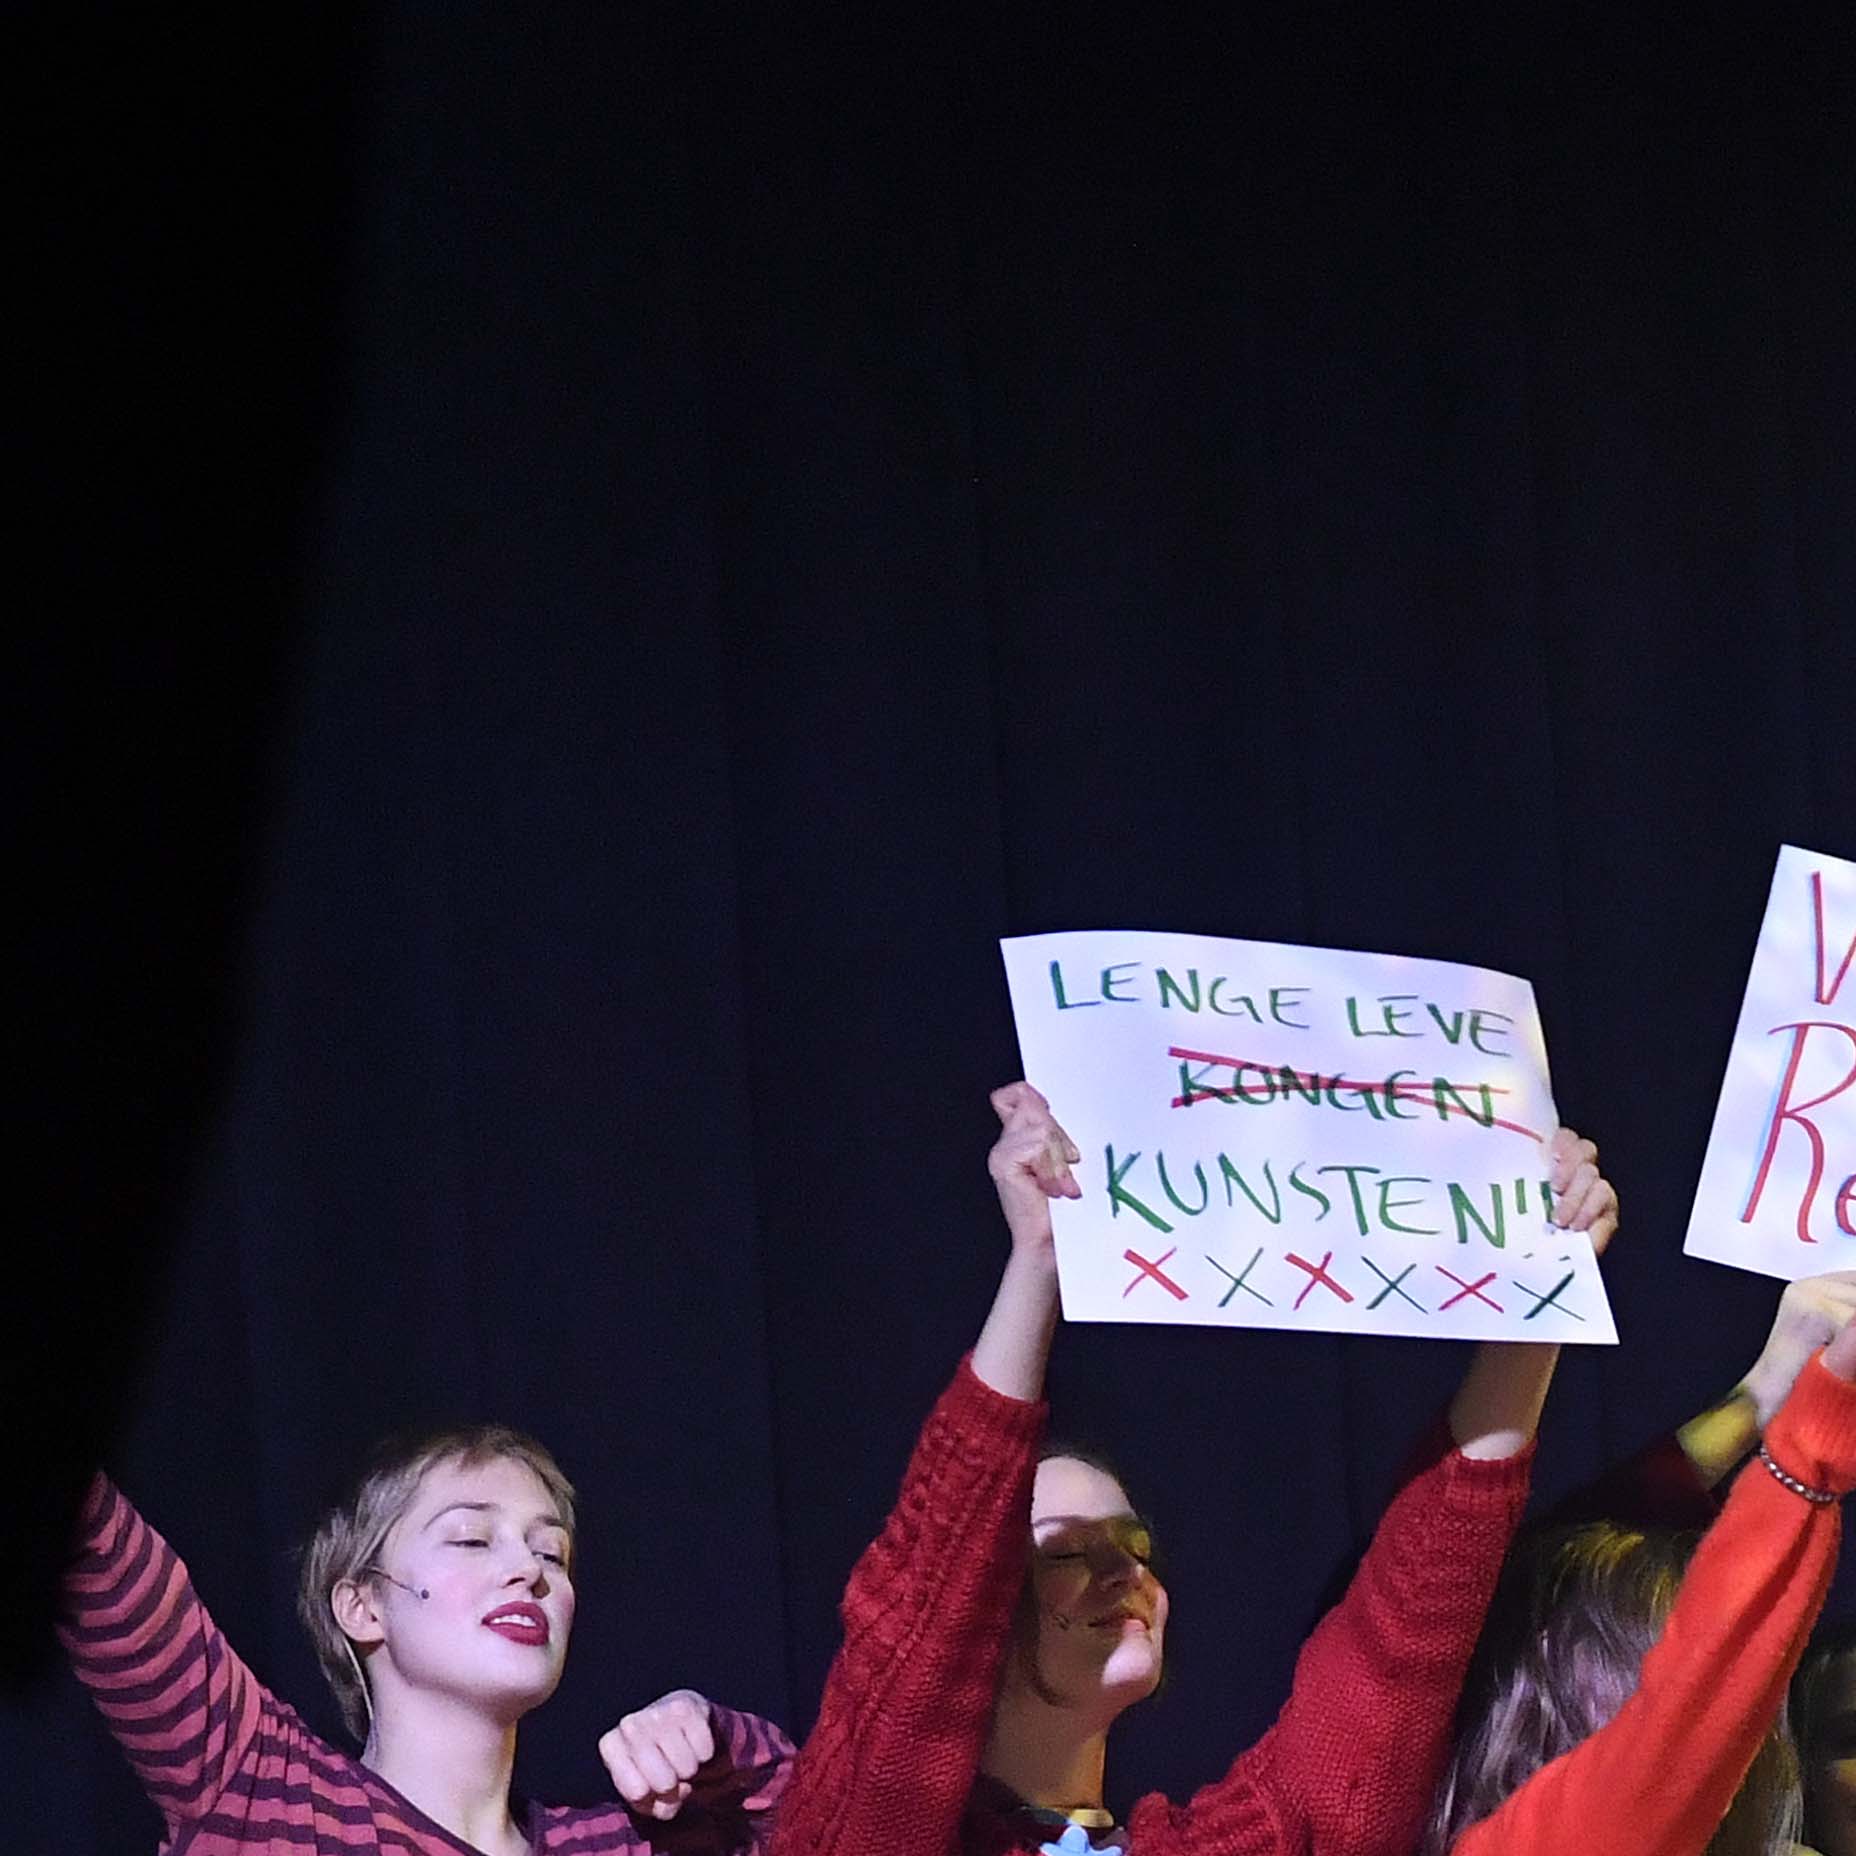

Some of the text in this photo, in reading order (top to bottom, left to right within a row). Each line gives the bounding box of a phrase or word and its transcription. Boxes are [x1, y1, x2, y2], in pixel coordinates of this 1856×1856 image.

[1048, 958, 1514, 1058] LENGE LEVE
[1178, 1059, 1495, 1128] KONGEN
